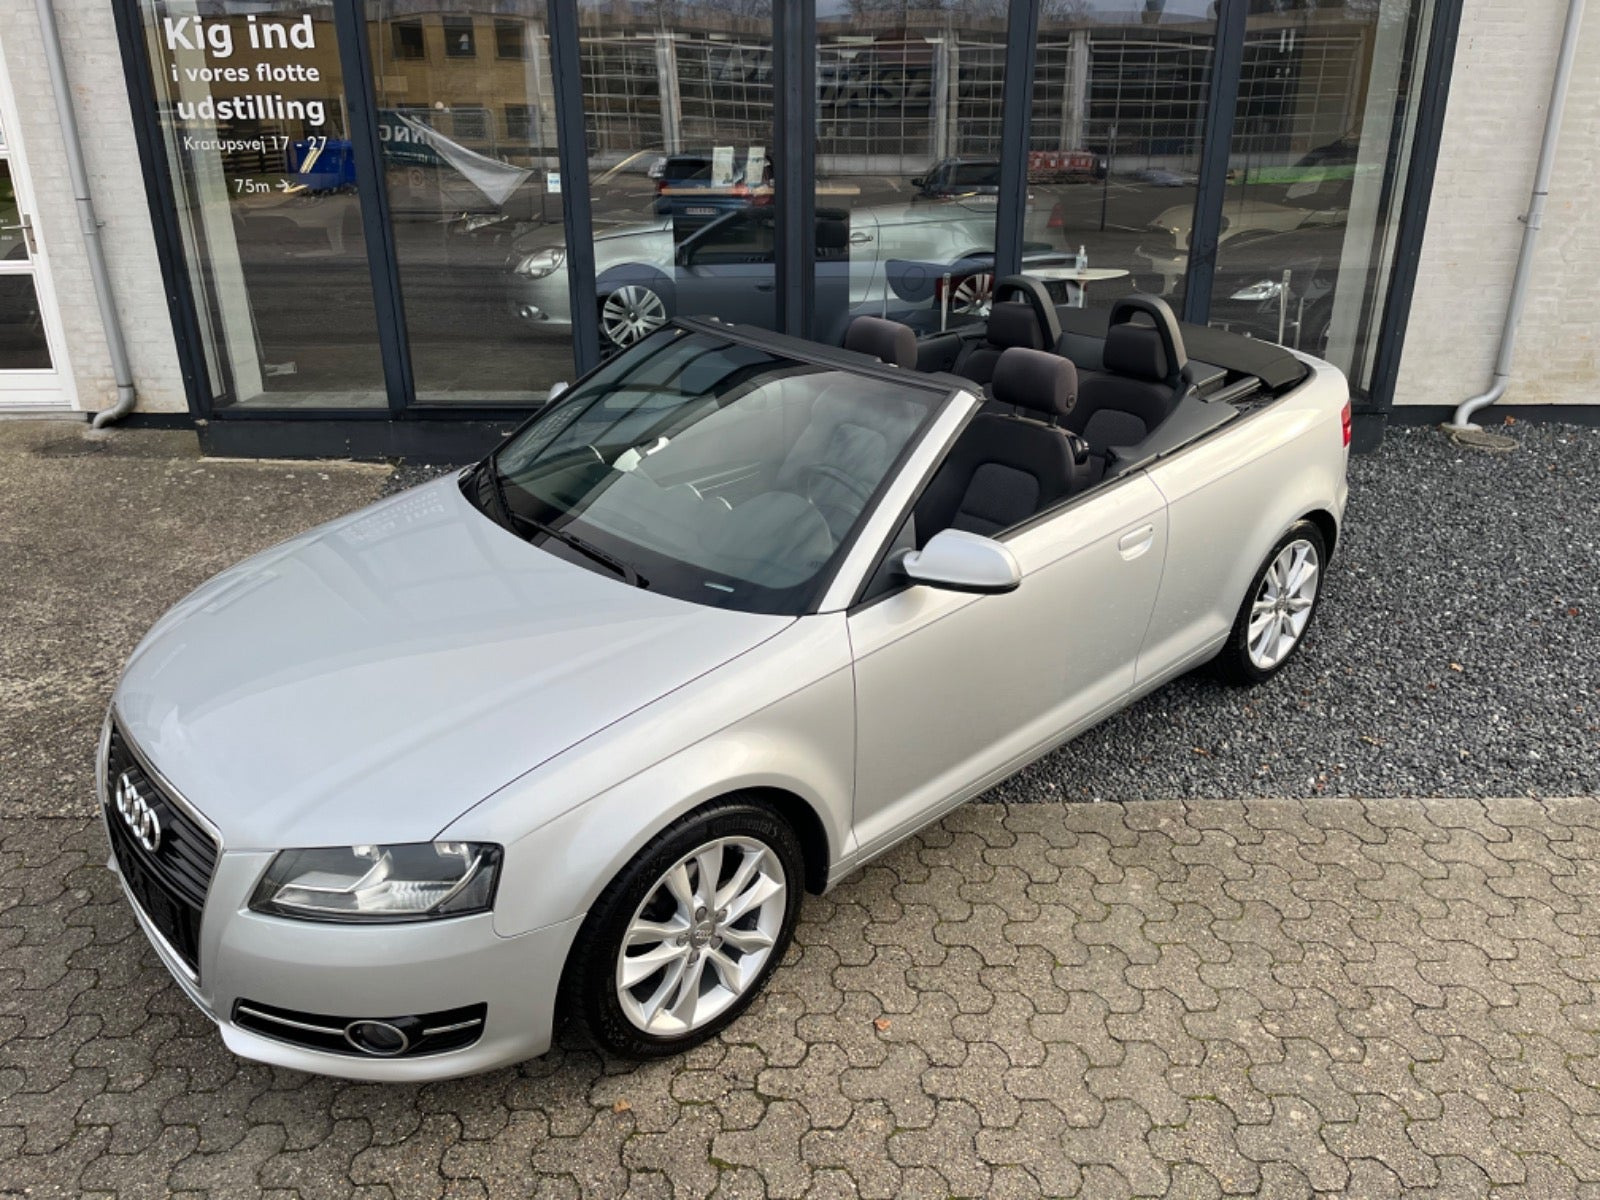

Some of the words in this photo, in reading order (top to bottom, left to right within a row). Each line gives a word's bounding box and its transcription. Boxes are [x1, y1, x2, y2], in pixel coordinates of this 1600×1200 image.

[163, 15, 234, 58] Kig
[248, 14, 315, 49] ind
[171, 64, 178, 82] i
[185, 67, 250, 82] vores
[256, 63, 320, 82] flotte
[177, 95, 326, 126] udstilling
[183, 136, 266, 154] Krarupsvej
[271, 136, 289, 150] 17
[307, 136, 327, 151] 27
[234, 178, 270, 193] 75m
